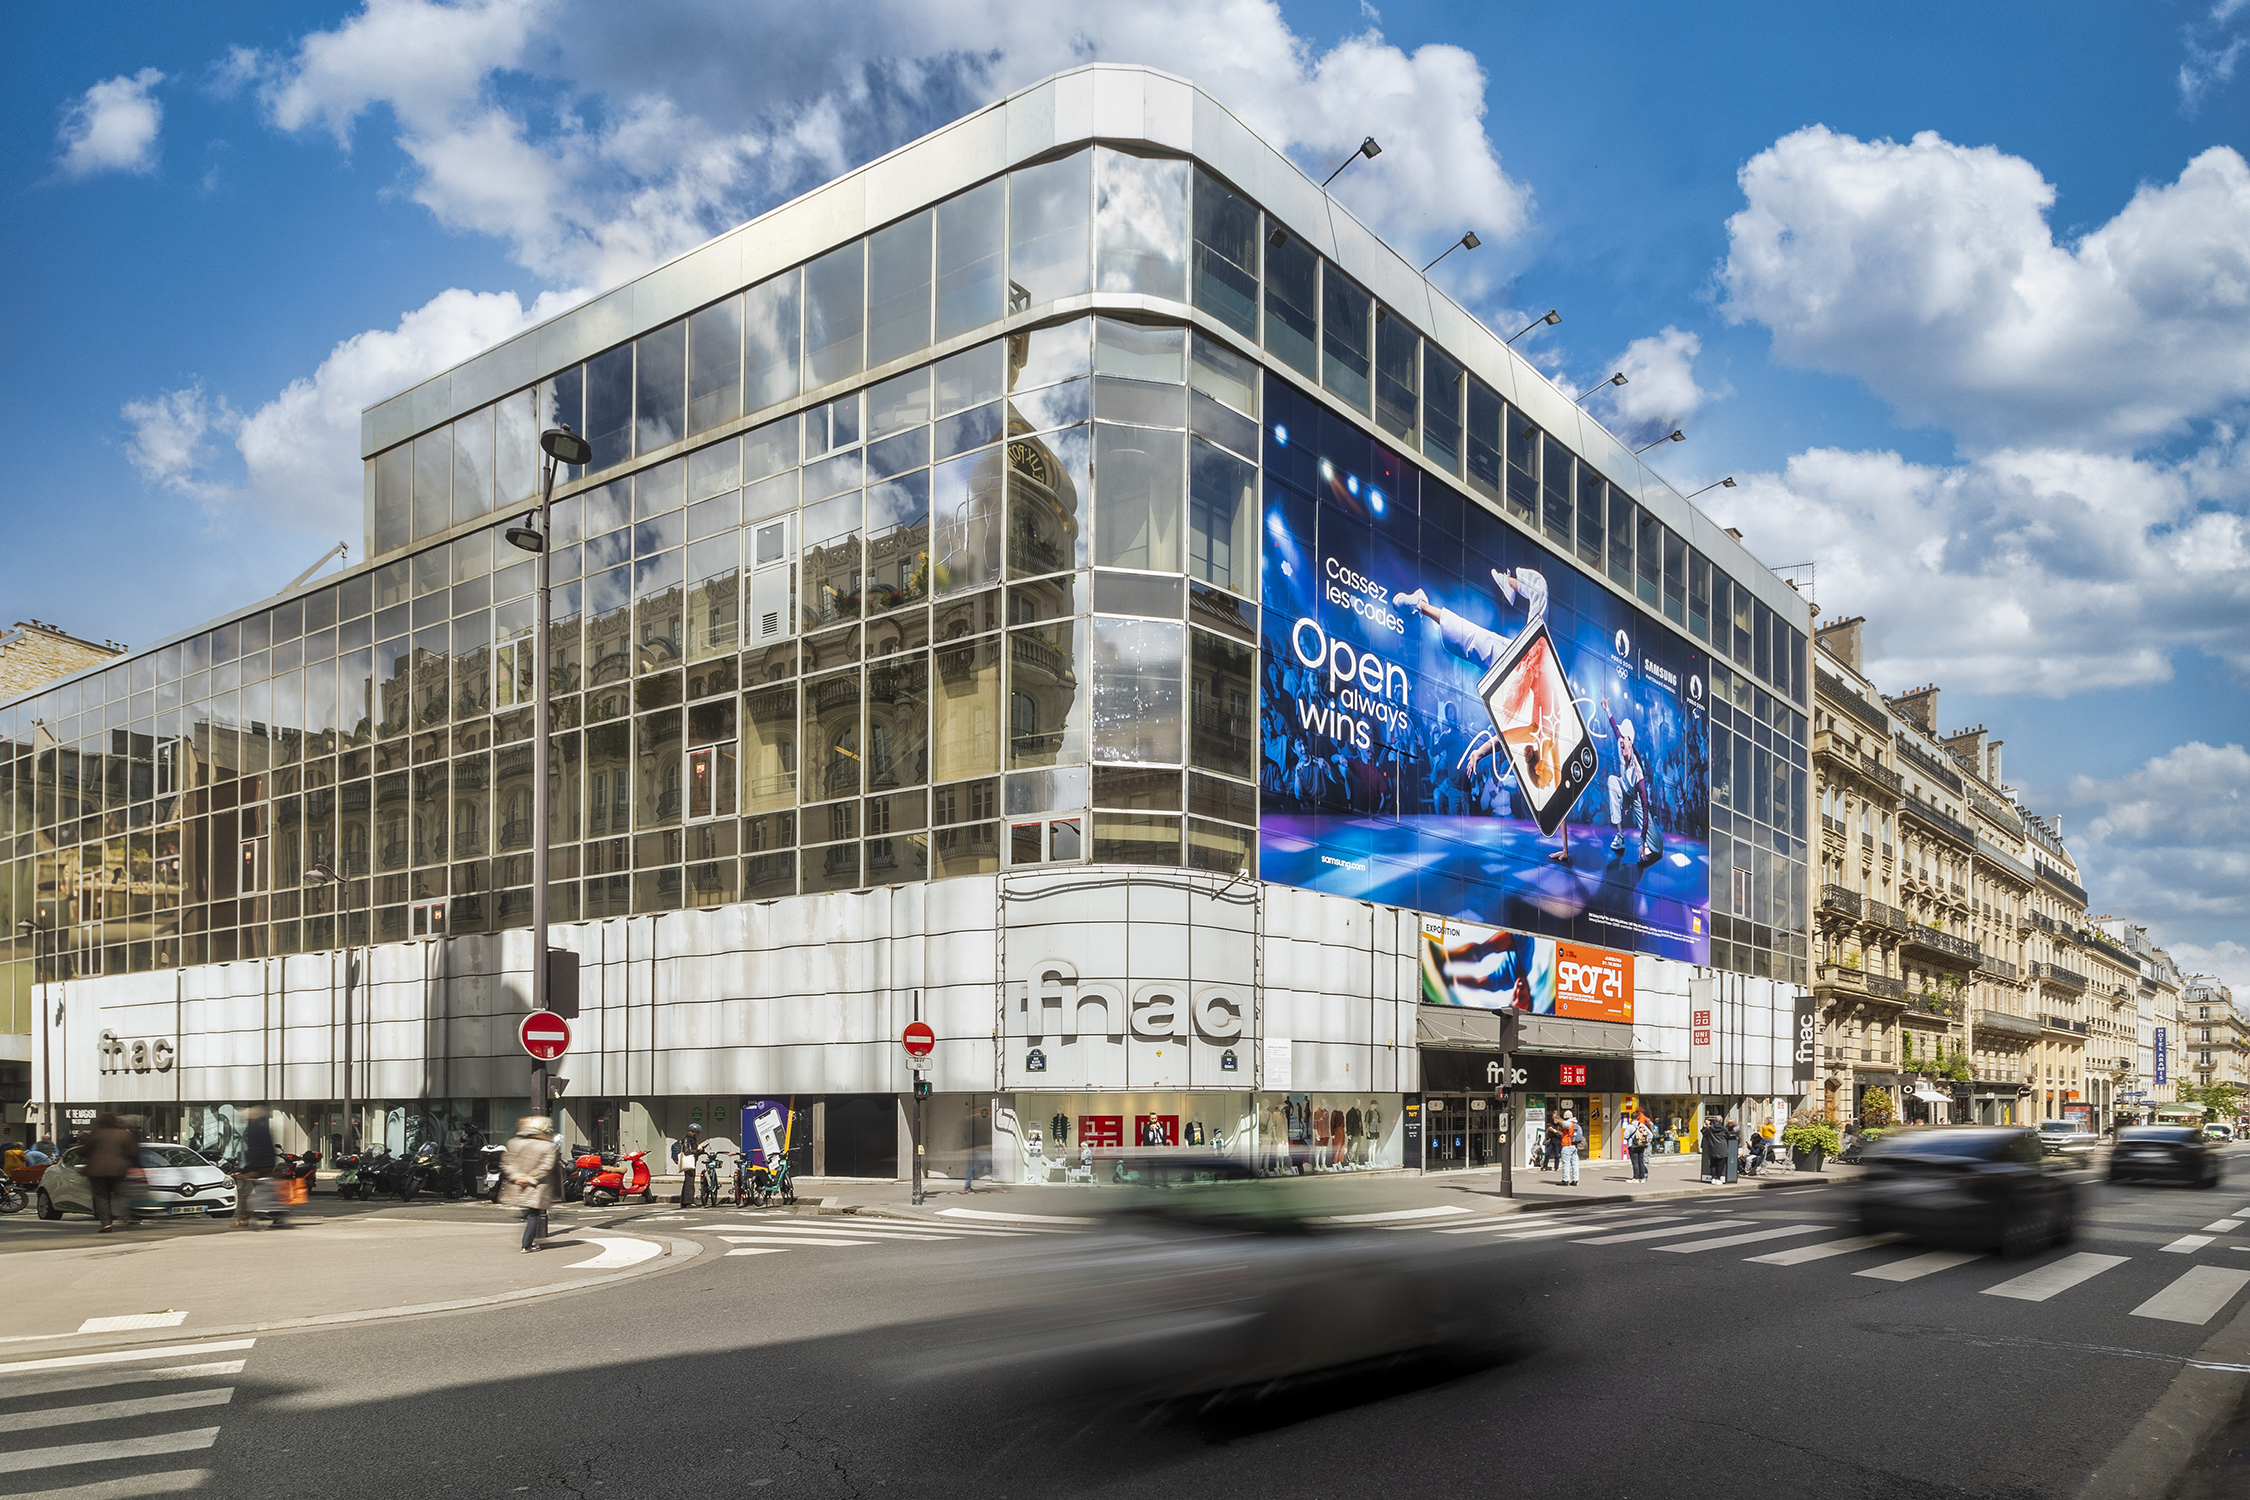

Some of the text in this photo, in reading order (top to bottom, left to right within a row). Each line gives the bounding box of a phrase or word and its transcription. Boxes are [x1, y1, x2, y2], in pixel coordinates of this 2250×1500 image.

[1325, 557, 1388, 605] Cassez
[1326, 579, 1405, 635] les codes
[1292, 617, 1408, 706] Open
[1644, 658, 1677, 687] SAMSUNG
[1298, 698, 1371, 749] wins
[1340, 688, 1408, 732] always
[1321, 855, 1366, 872] samsung.com
[1425, 924, 1461, 937] EXPOSITION
[1021, 959, 1243, 1047] fnac
[97, 1028, 174, 1075] fnac
[1795, 1014, 1814, 1064] fnac
[2157, 1053, 2165, 1080] ARAMIS
